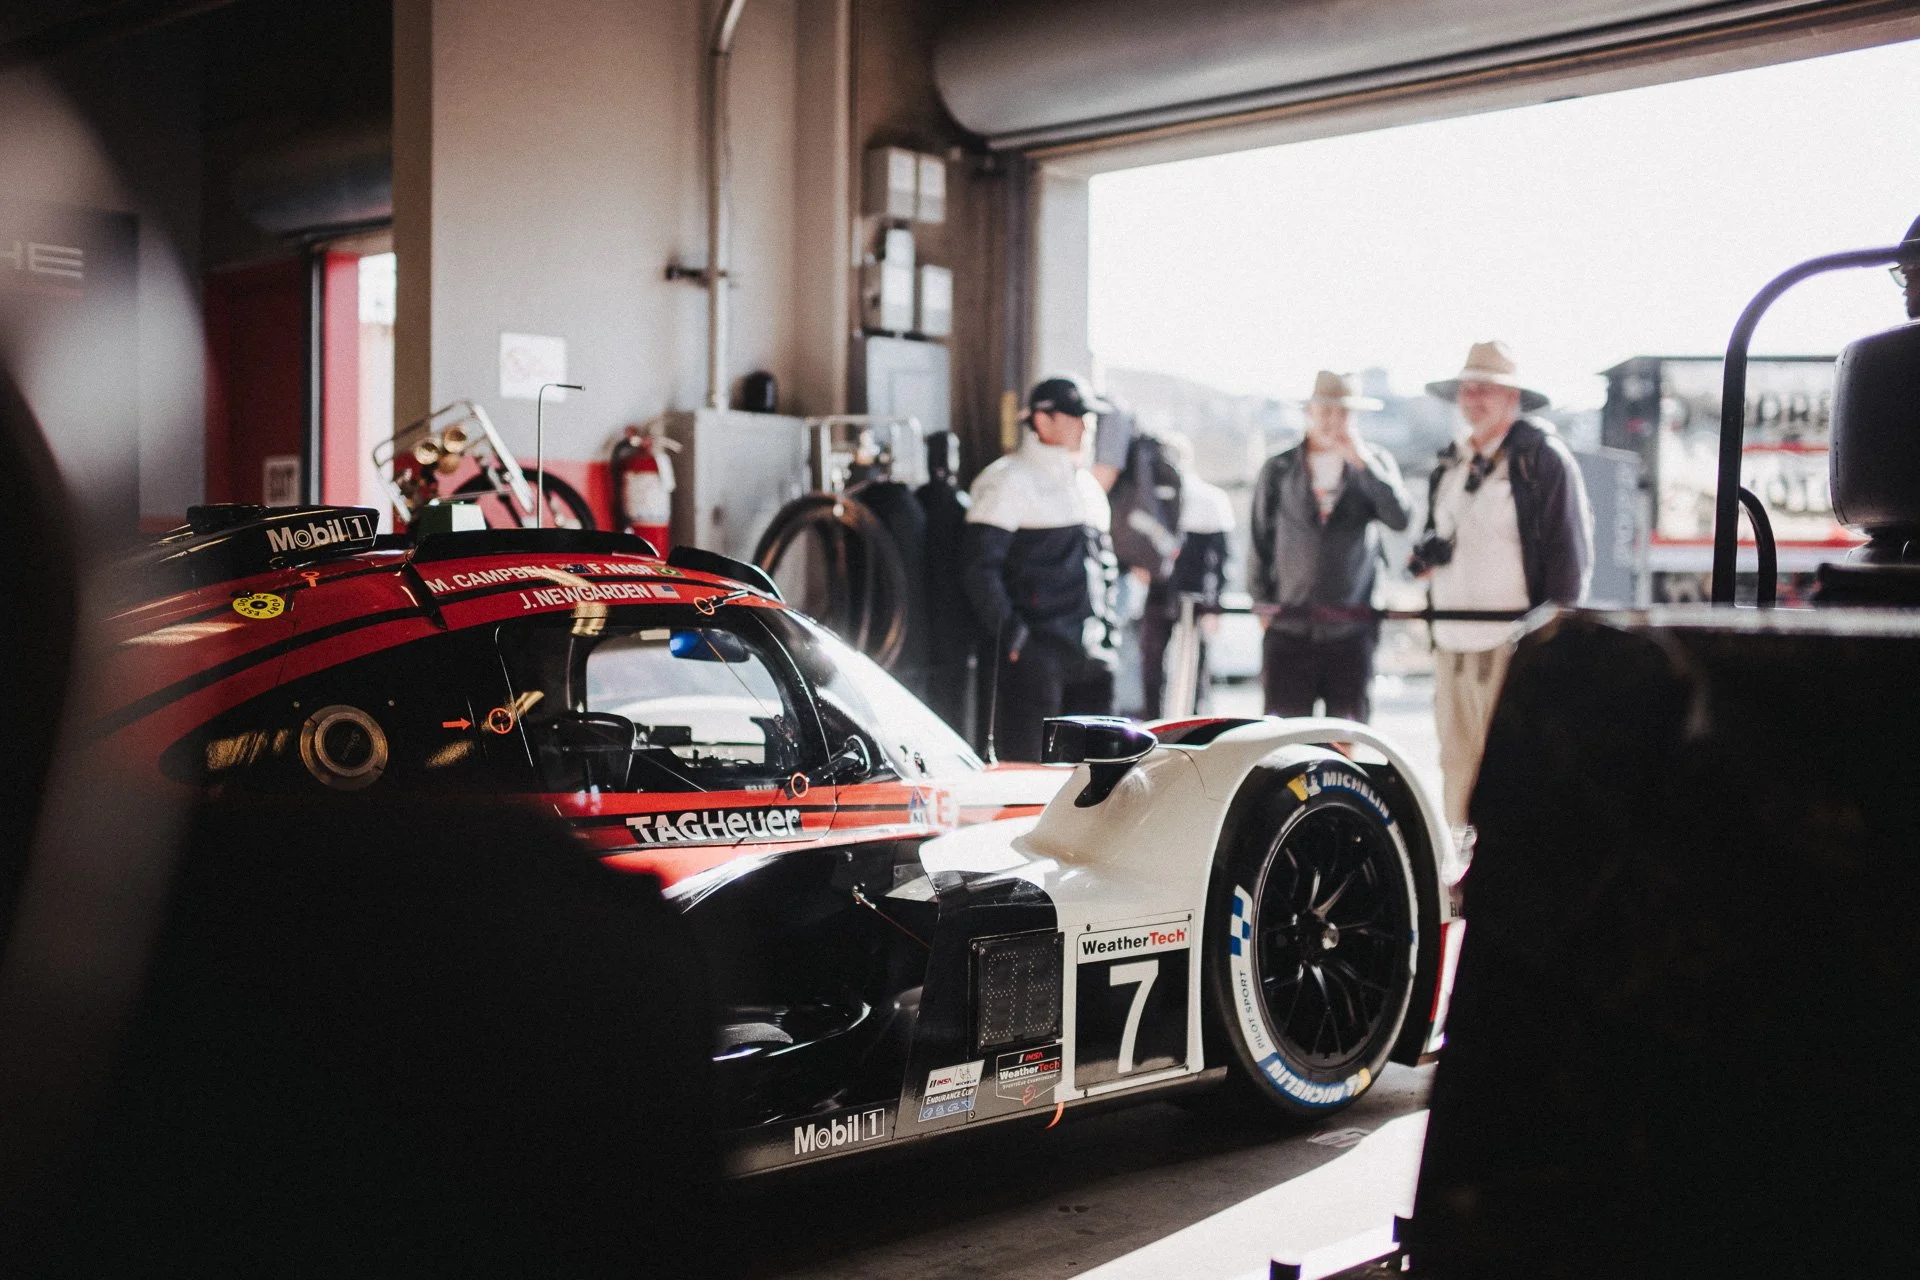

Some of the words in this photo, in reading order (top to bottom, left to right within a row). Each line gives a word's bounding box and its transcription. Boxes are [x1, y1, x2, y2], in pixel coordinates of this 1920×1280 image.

[266, 518, 346, 552] Mobil
[424, 578, 456, 594] M.
[520, 592, 536, 610] J.
[533, 583, 652, 605] NEWGARDEN
[1323, 771, 1390, 819] MICHELIN
[1082, 928, 1185, 956] WeatherTech
[1239, 970, 1253, 1014] SPORT
[1110, 959, 1159, 1073] 7
[1248, 1017, 1265, 1049] PILOT
[1000, 1060, 1060, 1080] WeatherTech
[1267, 1059, 1345, 1104] MICHELIN
[794, 1114, 859, 1155] Mobil
